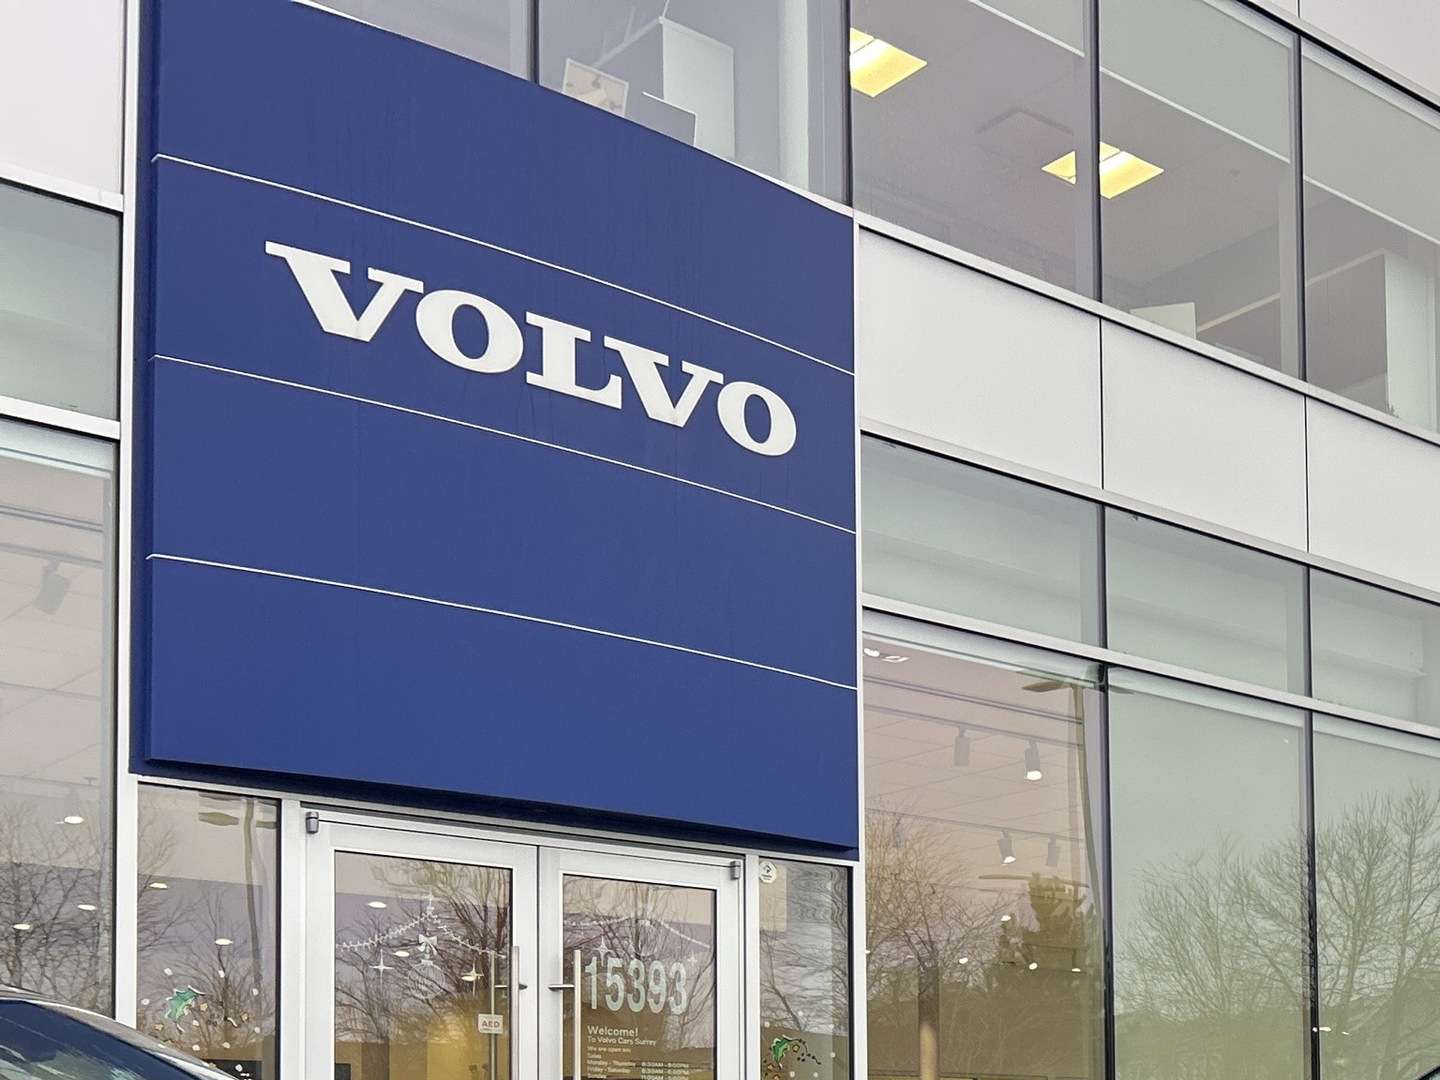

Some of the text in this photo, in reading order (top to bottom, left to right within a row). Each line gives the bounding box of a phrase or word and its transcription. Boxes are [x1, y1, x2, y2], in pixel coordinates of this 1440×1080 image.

[265, 240, 797, 457] VOLVO
[584, 956, 688, 1015] 15393
[482, 1020, 500, 1028] AED
[587, 1025, 639, 1037] Welcome!
